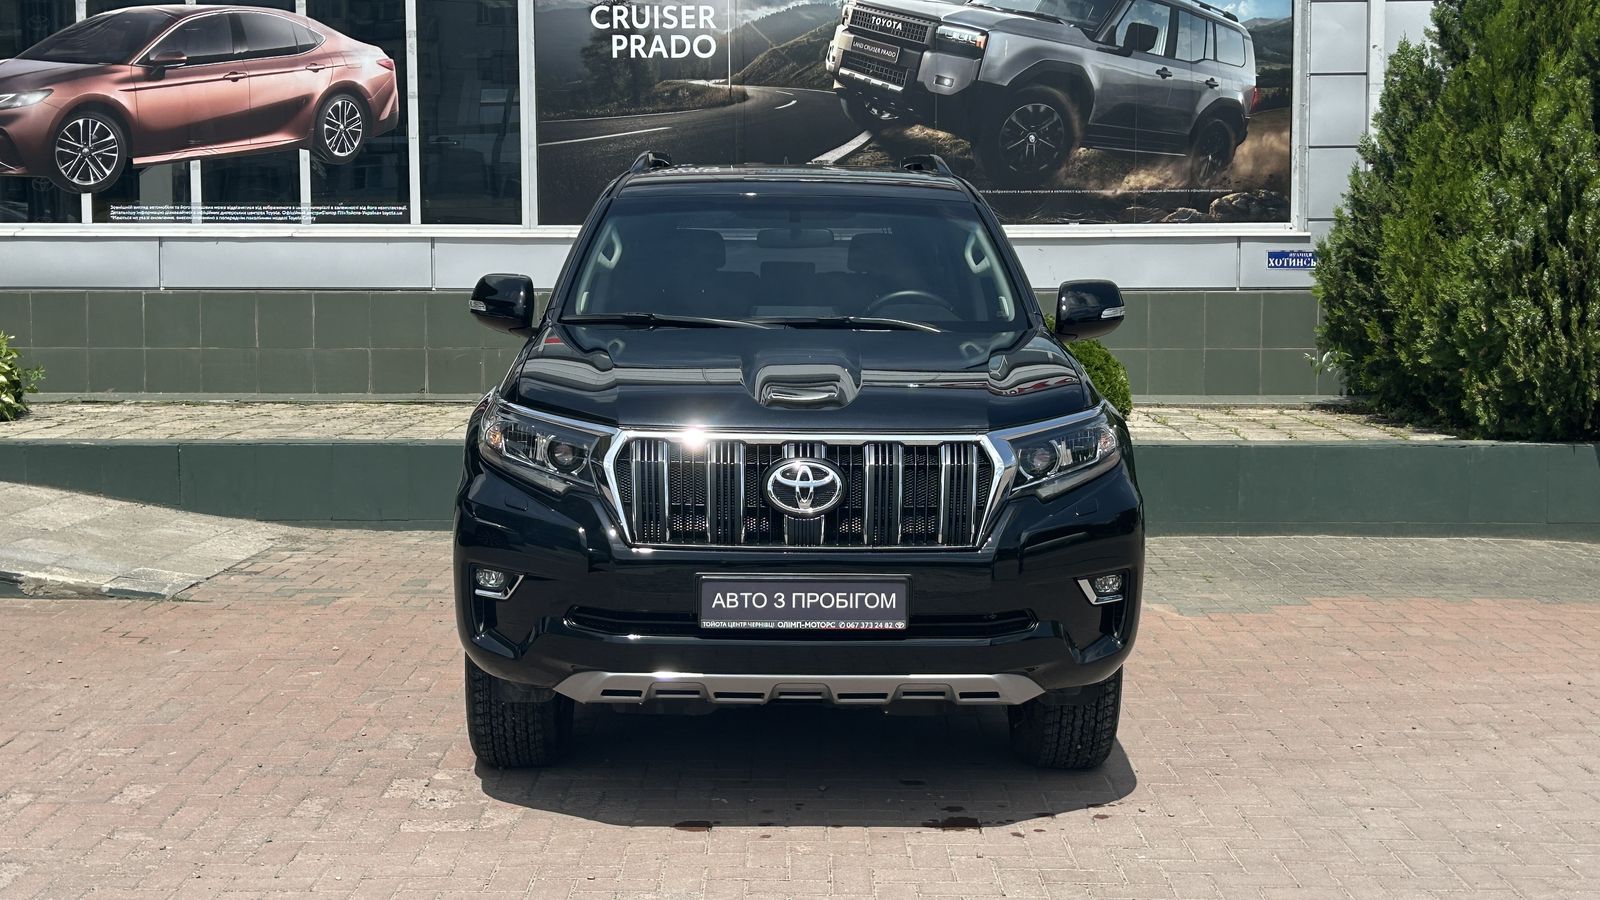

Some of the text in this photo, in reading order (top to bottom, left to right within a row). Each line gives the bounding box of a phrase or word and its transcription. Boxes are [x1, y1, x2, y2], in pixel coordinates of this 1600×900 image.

[590, 5, 717, 29] CRUISER
[871, 16, 902, 30] TOYOTA
[611, 34, 717, 59] PRADO
[853, 41, 864, 49] LAND
[881, 48, 897, 58] PRADO
[711, 592, 896, 609] АВТО З ПРОБІГОМ
[702, 620, 893, 629] ТОЙОТА ЦЕНТР ЧЕРНІВЦІ ОЛІМП-МОТОРС 067 373 24 82
